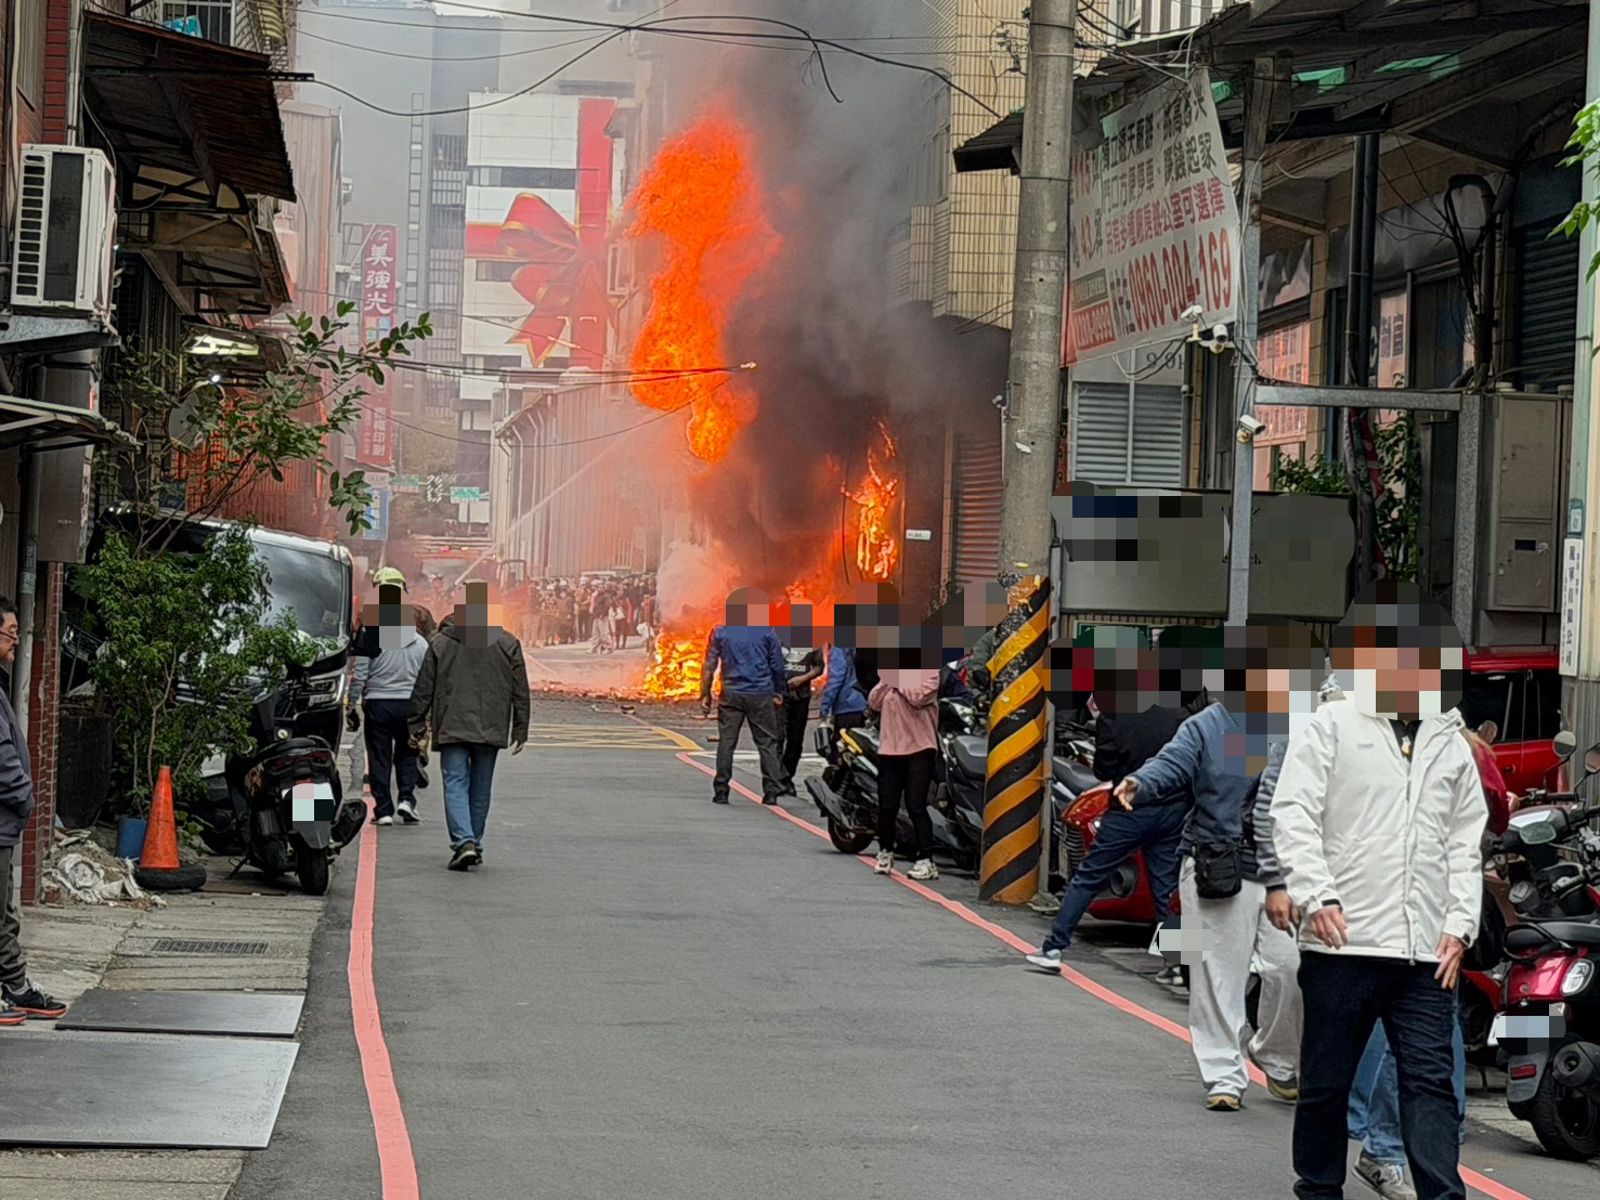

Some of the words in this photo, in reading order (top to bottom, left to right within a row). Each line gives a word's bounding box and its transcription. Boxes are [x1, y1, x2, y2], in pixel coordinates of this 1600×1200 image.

[363, 243, 394, 314] 美強光
[1128, 227, 1232, 332] 0960-004-169
